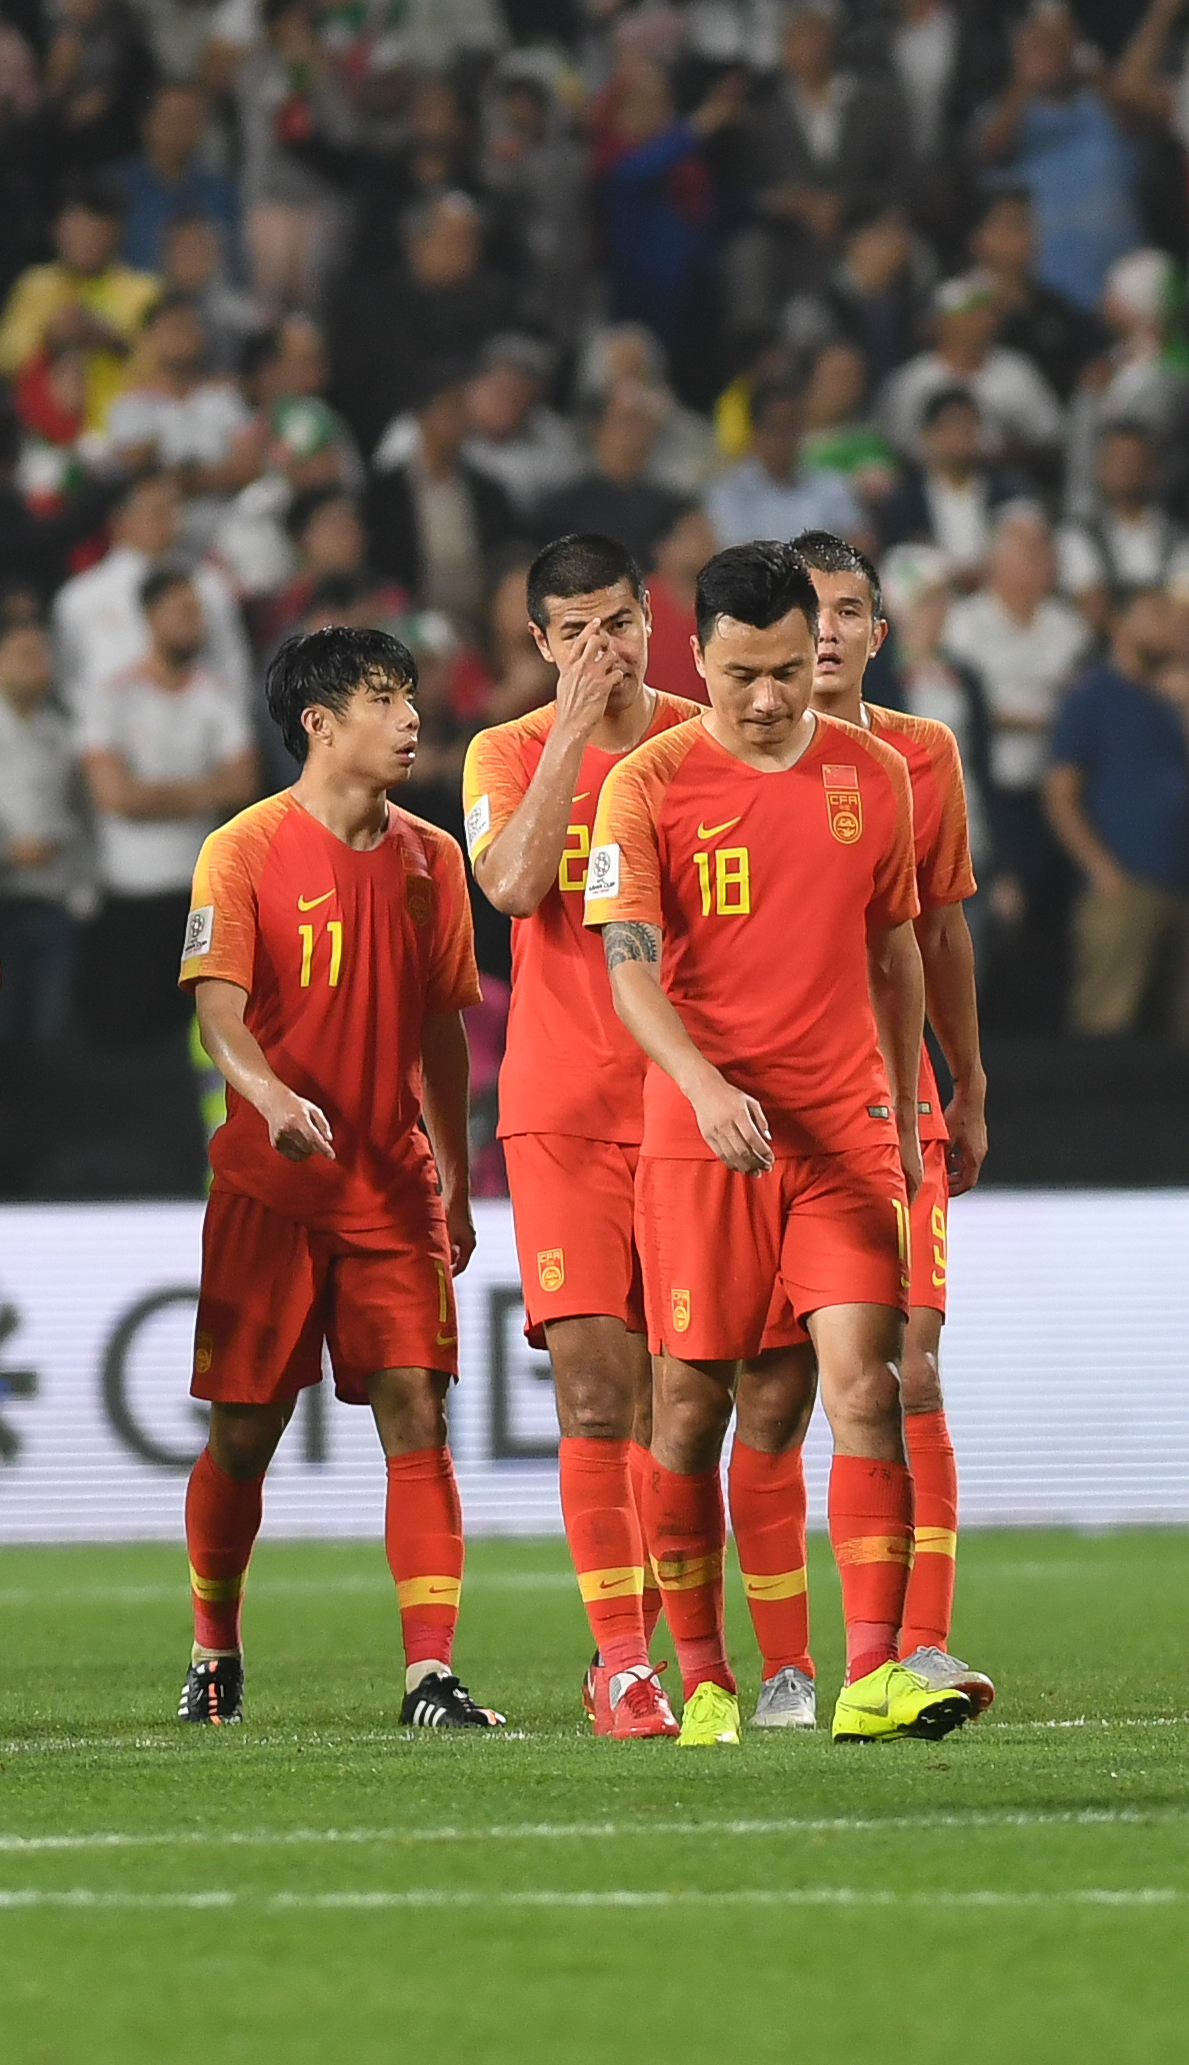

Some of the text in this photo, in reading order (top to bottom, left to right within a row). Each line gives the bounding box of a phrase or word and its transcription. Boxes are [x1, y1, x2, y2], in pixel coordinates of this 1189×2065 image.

[829, 795, 858, 805] CFA
[559, 825, 590, 891] 2
[693, 847, 750, 916] 18
[298, 921, 342, 988] 11
